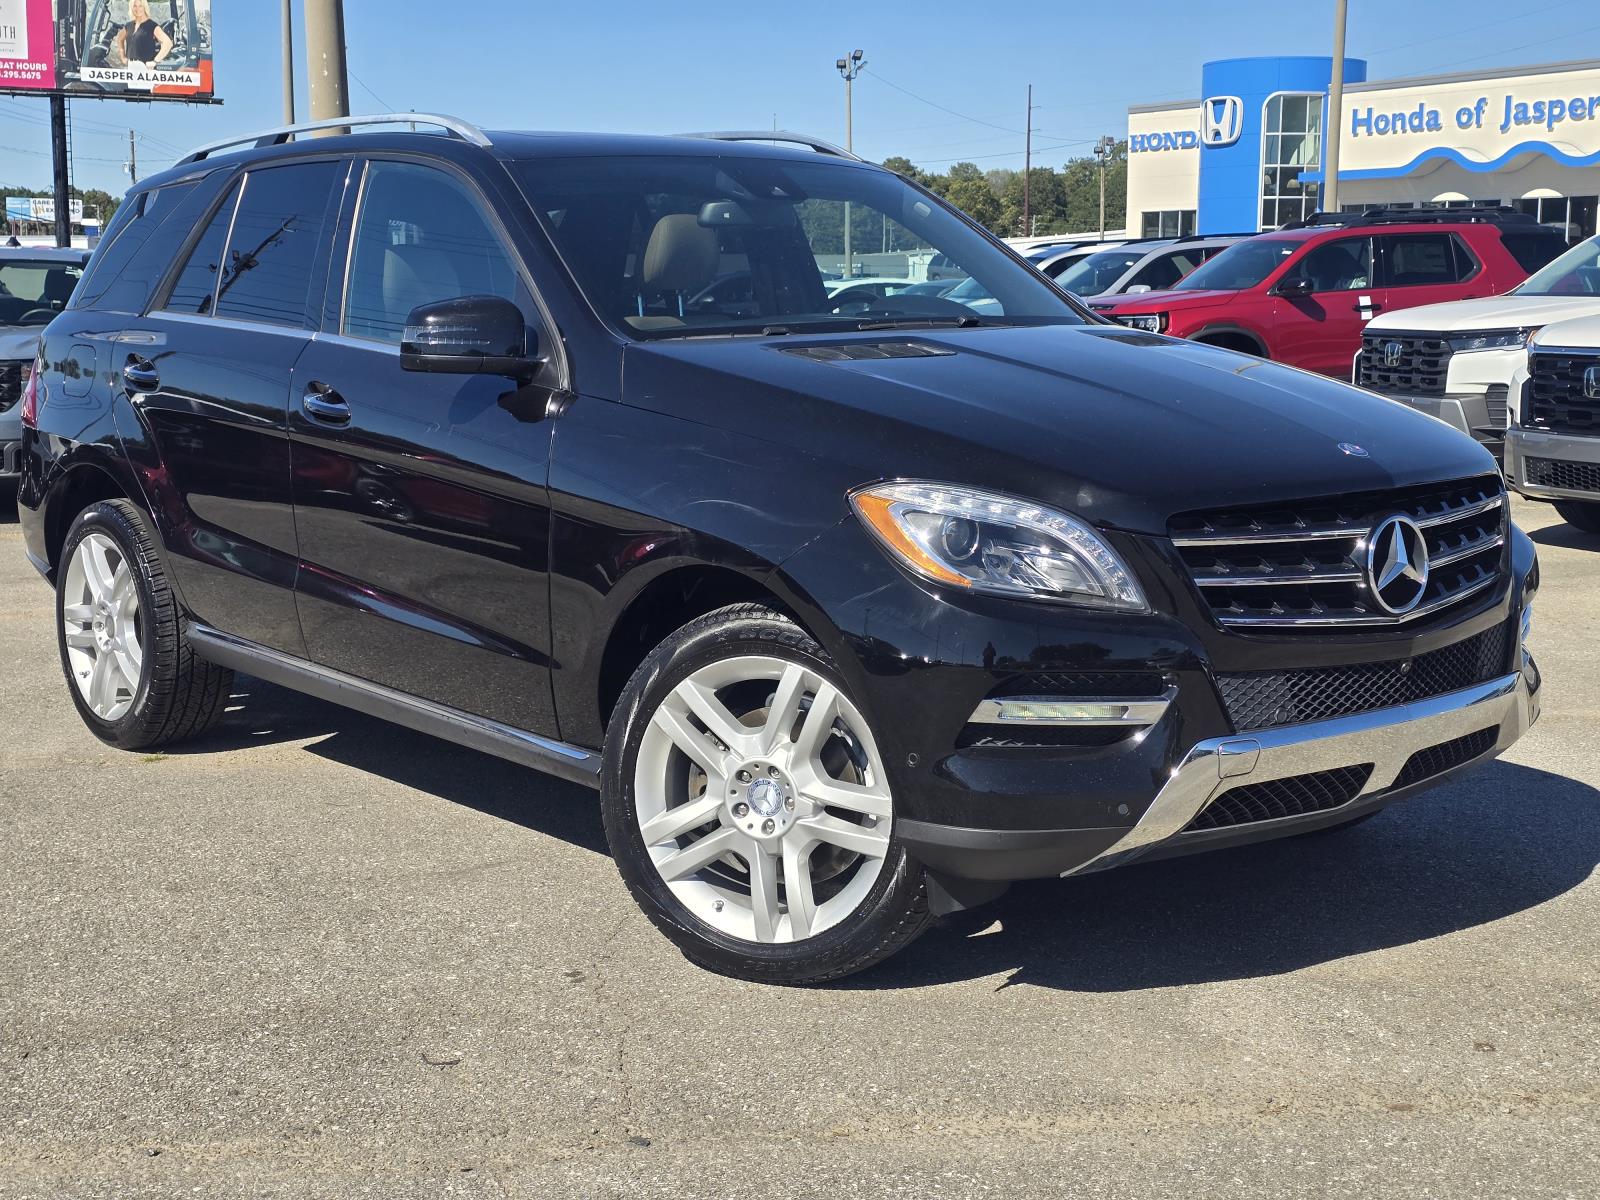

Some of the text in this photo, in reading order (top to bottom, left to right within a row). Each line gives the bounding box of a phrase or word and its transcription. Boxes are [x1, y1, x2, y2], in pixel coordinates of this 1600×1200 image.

[0, 26, 16, 39] TH
[16, 62, 48, 71] HOURS
[88, 71, 192, 83] JASPER ALABAMA
[1352, 95, 1600, 137] Honda of Jasper
[1129, 130, 1200, 152] HOND
